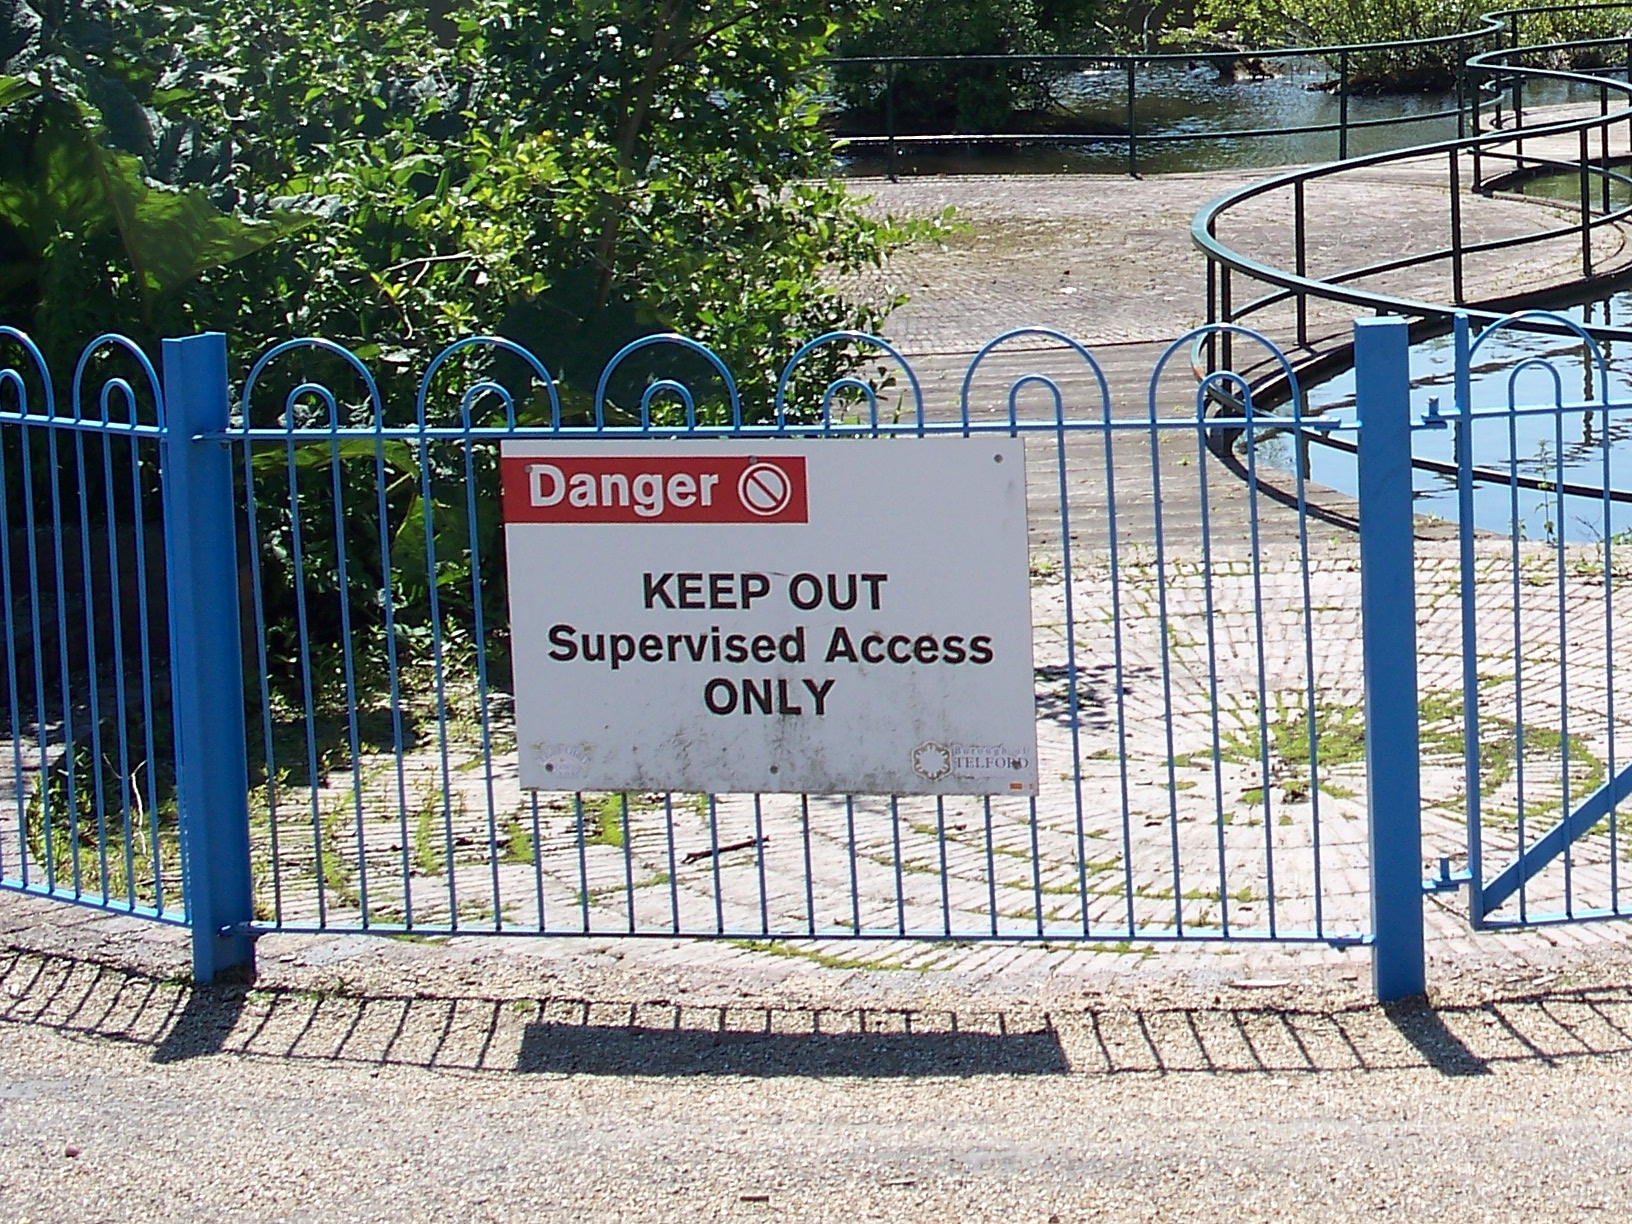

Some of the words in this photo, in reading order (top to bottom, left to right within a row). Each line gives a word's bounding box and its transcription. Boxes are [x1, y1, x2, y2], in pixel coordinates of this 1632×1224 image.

[528, 463, 719, 517] Danger
[643, 572, 770, 610] KEEP
[789, 572, 889, 611] OUT
[547, 624, 806, 670] Supervised
[826, 626, 994, 665] Access
[704, 678, 835, 716] ONLY
